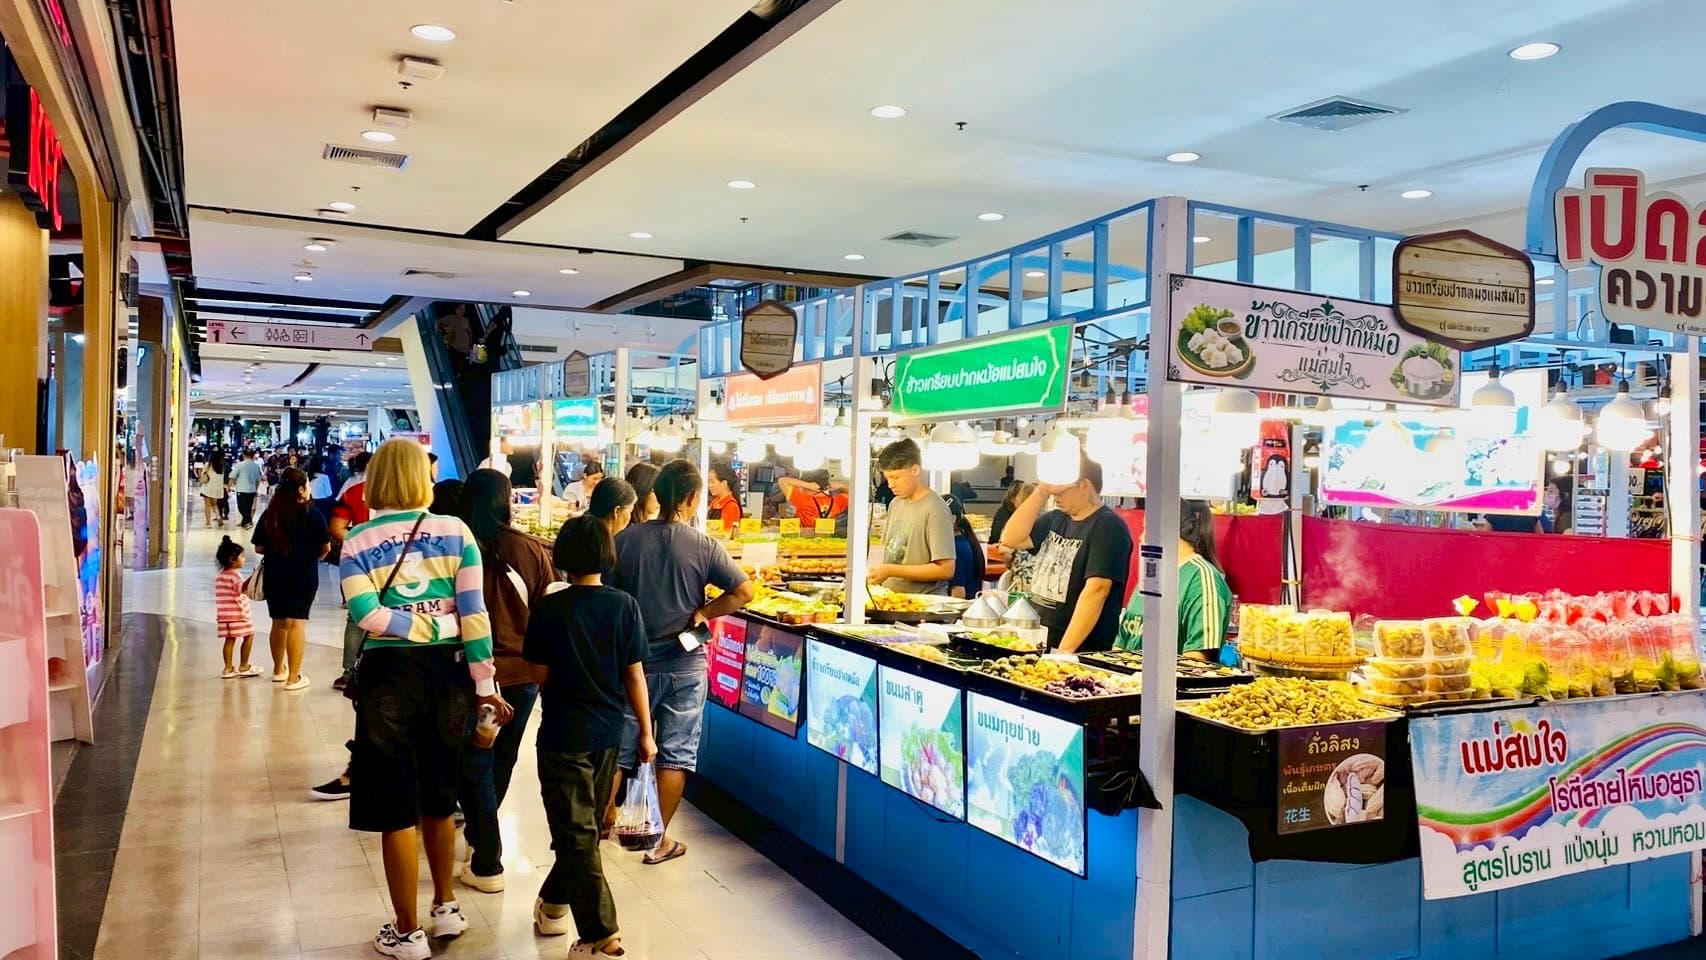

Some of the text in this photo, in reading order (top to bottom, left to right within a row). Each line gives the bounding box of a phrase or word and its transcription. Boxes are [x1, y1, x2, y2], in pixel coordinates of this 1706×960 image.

[1563, 174, 1706, 267] เปิด
[212, 329, 220, 342] 1
[1298, 350, 1351, 376] แม่สมใจ
[885, 680, 924, 714] ขนมสาคู
[977, 711, 1041, 747] ขนมกุยช่าย
[1308, 731, 1360, 754] ถั่วลิสง
[1461, 720, 1567, 774] แม่สมใจ
[1285, 807, 1311, 824] 花生
[1462, 846, 1551, 891] สูตรโบราน
[1632, 821, 1705, 852] หวานหอม
